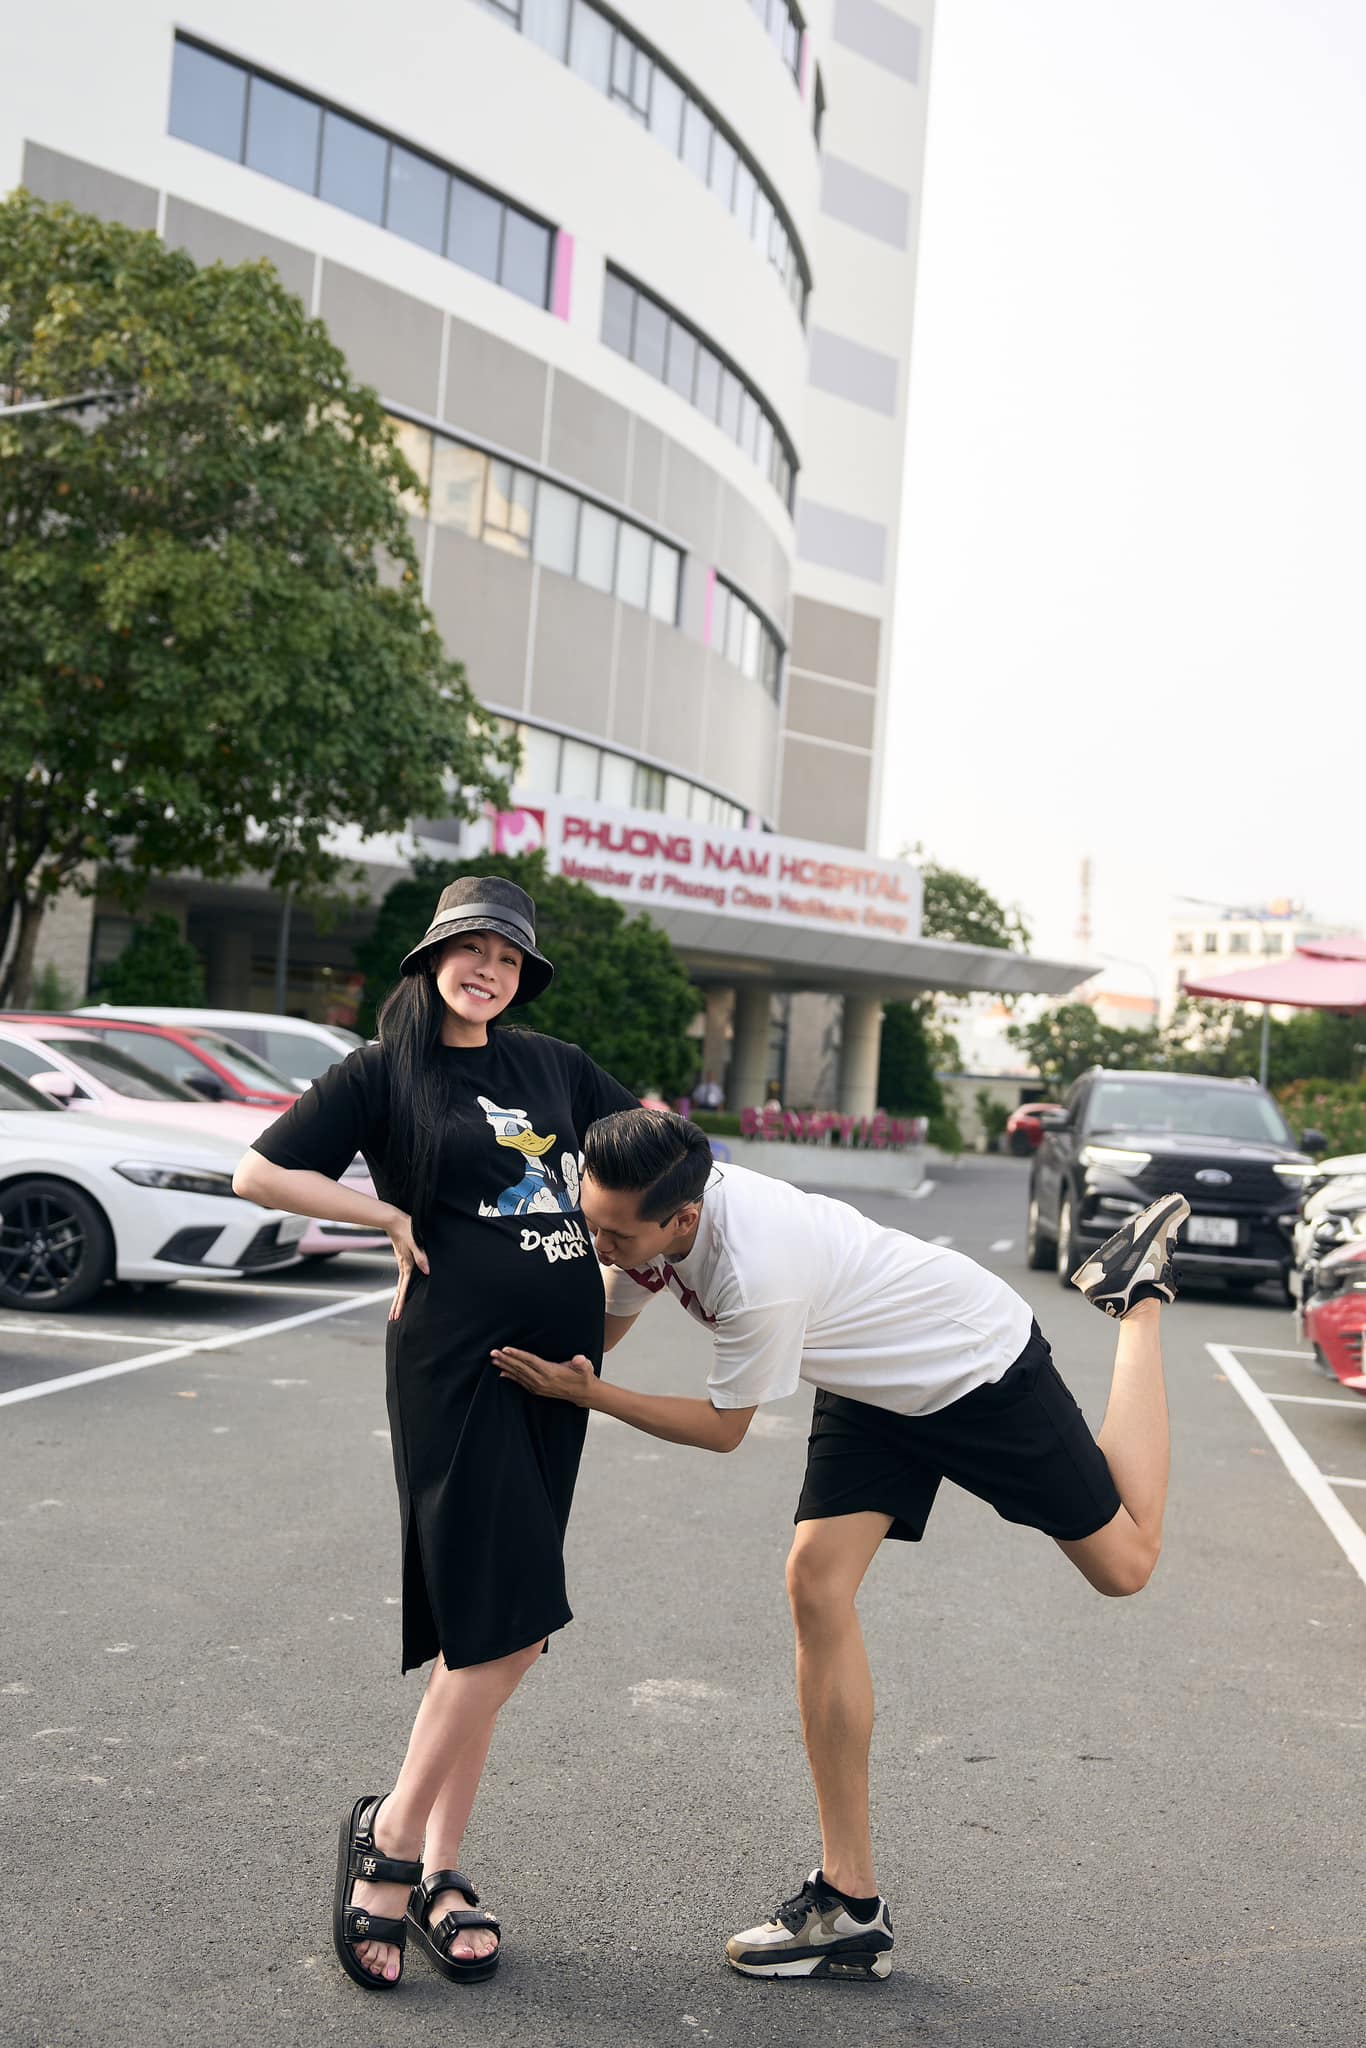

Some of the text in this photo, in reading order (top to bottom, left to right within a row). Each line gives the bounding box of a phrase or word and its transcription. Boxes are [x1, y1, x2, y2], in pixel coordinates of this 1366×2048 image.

[561, 856, 634, 888] Member
[639, 871, 657, 891] of
[562, 815, 910, 903] PHUONG NAM HOSPITAL
[520, 1218, 589, 1251] Donald
